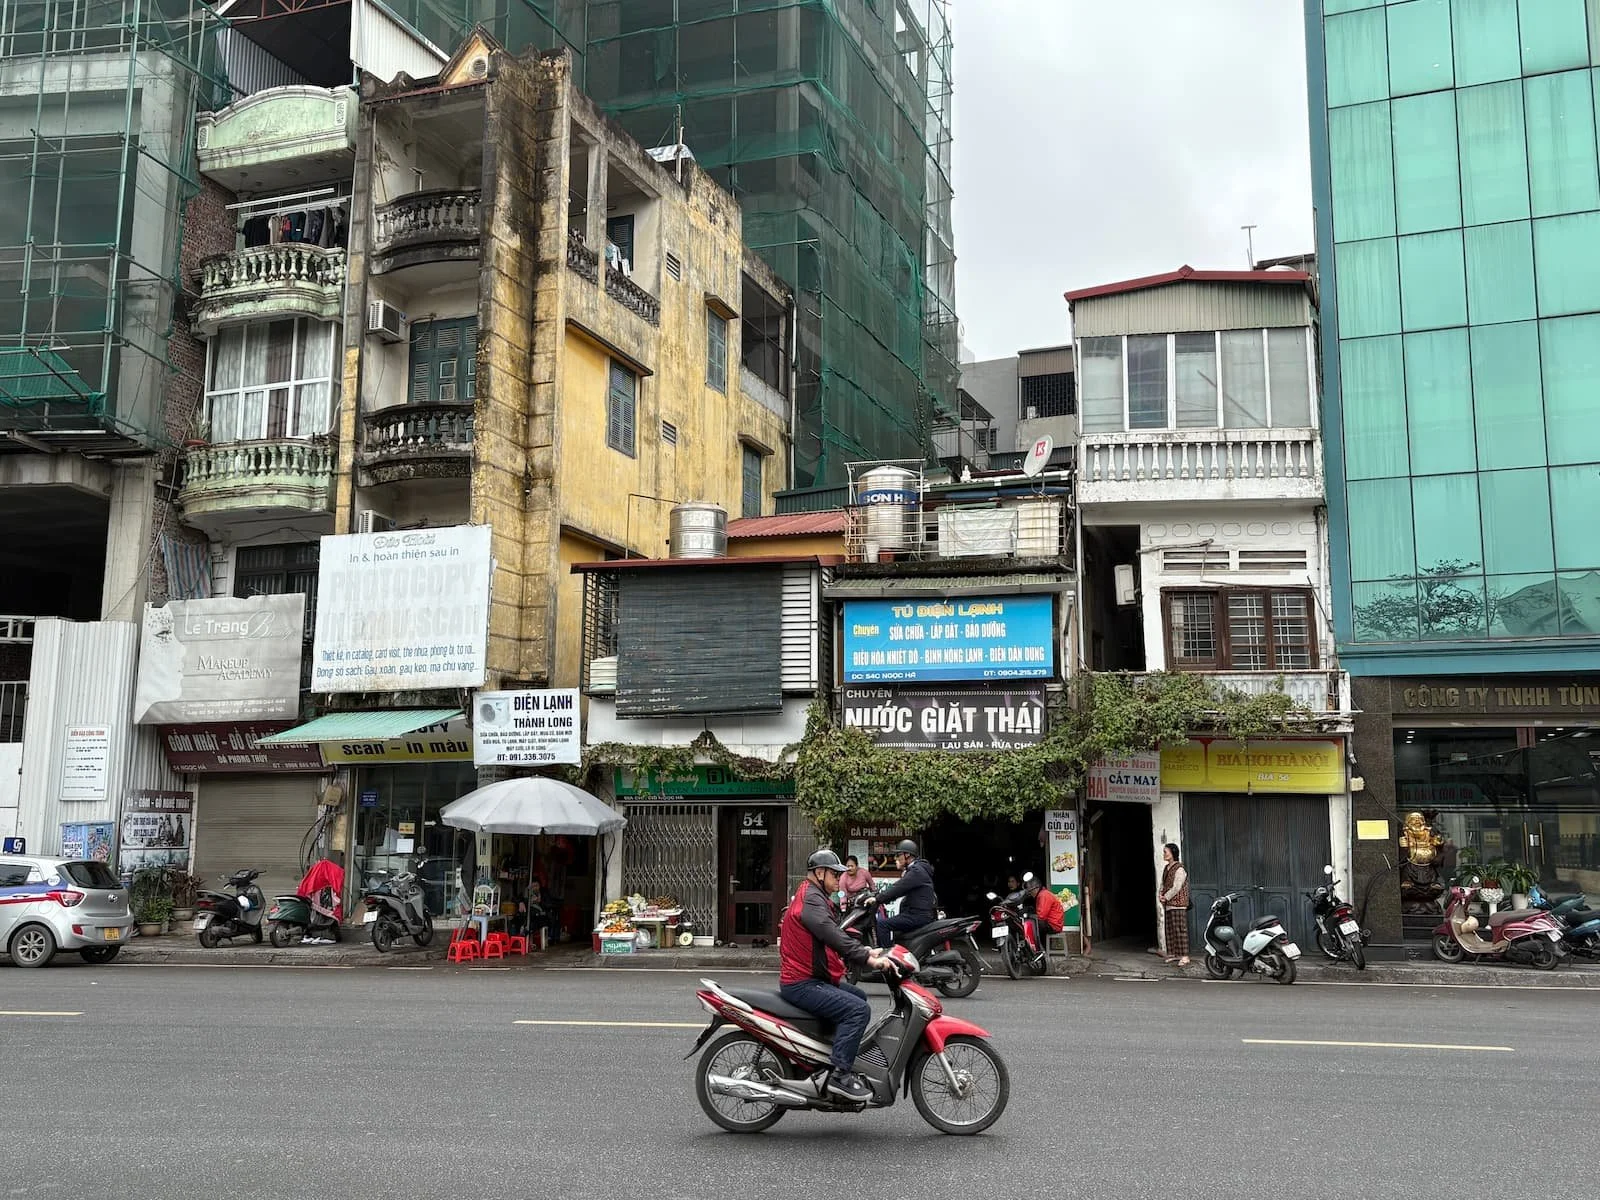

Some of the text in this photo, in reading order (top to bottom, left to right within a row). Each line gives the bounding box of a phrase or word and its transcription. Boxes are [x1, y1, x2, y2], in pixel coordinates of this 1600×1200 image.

[349, 554, 359, 563] In
[430, 549, 447, 557] sau
[450, 546, 459, 556] in
[958, 603, 1003, 618] LẠNH
[205, 620, 249, 639] Trang
[846, 688, 893, 698] CHUYÊN
[1404, 684, 1459, 707] CÔNG
[1465, 687, 1489, 706] TY
[1494, 687, 1550, 706] TNHH
[514, 692, 573, 714] ĐIỆN LẠNH
[513, 715, 573, 729] THÀNH LONG
[846, 700, 1041, 739] NƯỚC GIẶT THÁI
[192, 731, 220, 754] NHẬT
[342, 739, 468, 755] scan in màu
[1132, 759, 1156, 769] Nam
[1217, 751, 1329, 771] BIA HƠI HÀ NỘI
[1109, 771, 1158, 786] CẮT MAY
[1256, 773, 1274, 782] BIA
[743, 811, 764, 827] 54
[862, 825, 878, 837] PHÊ
